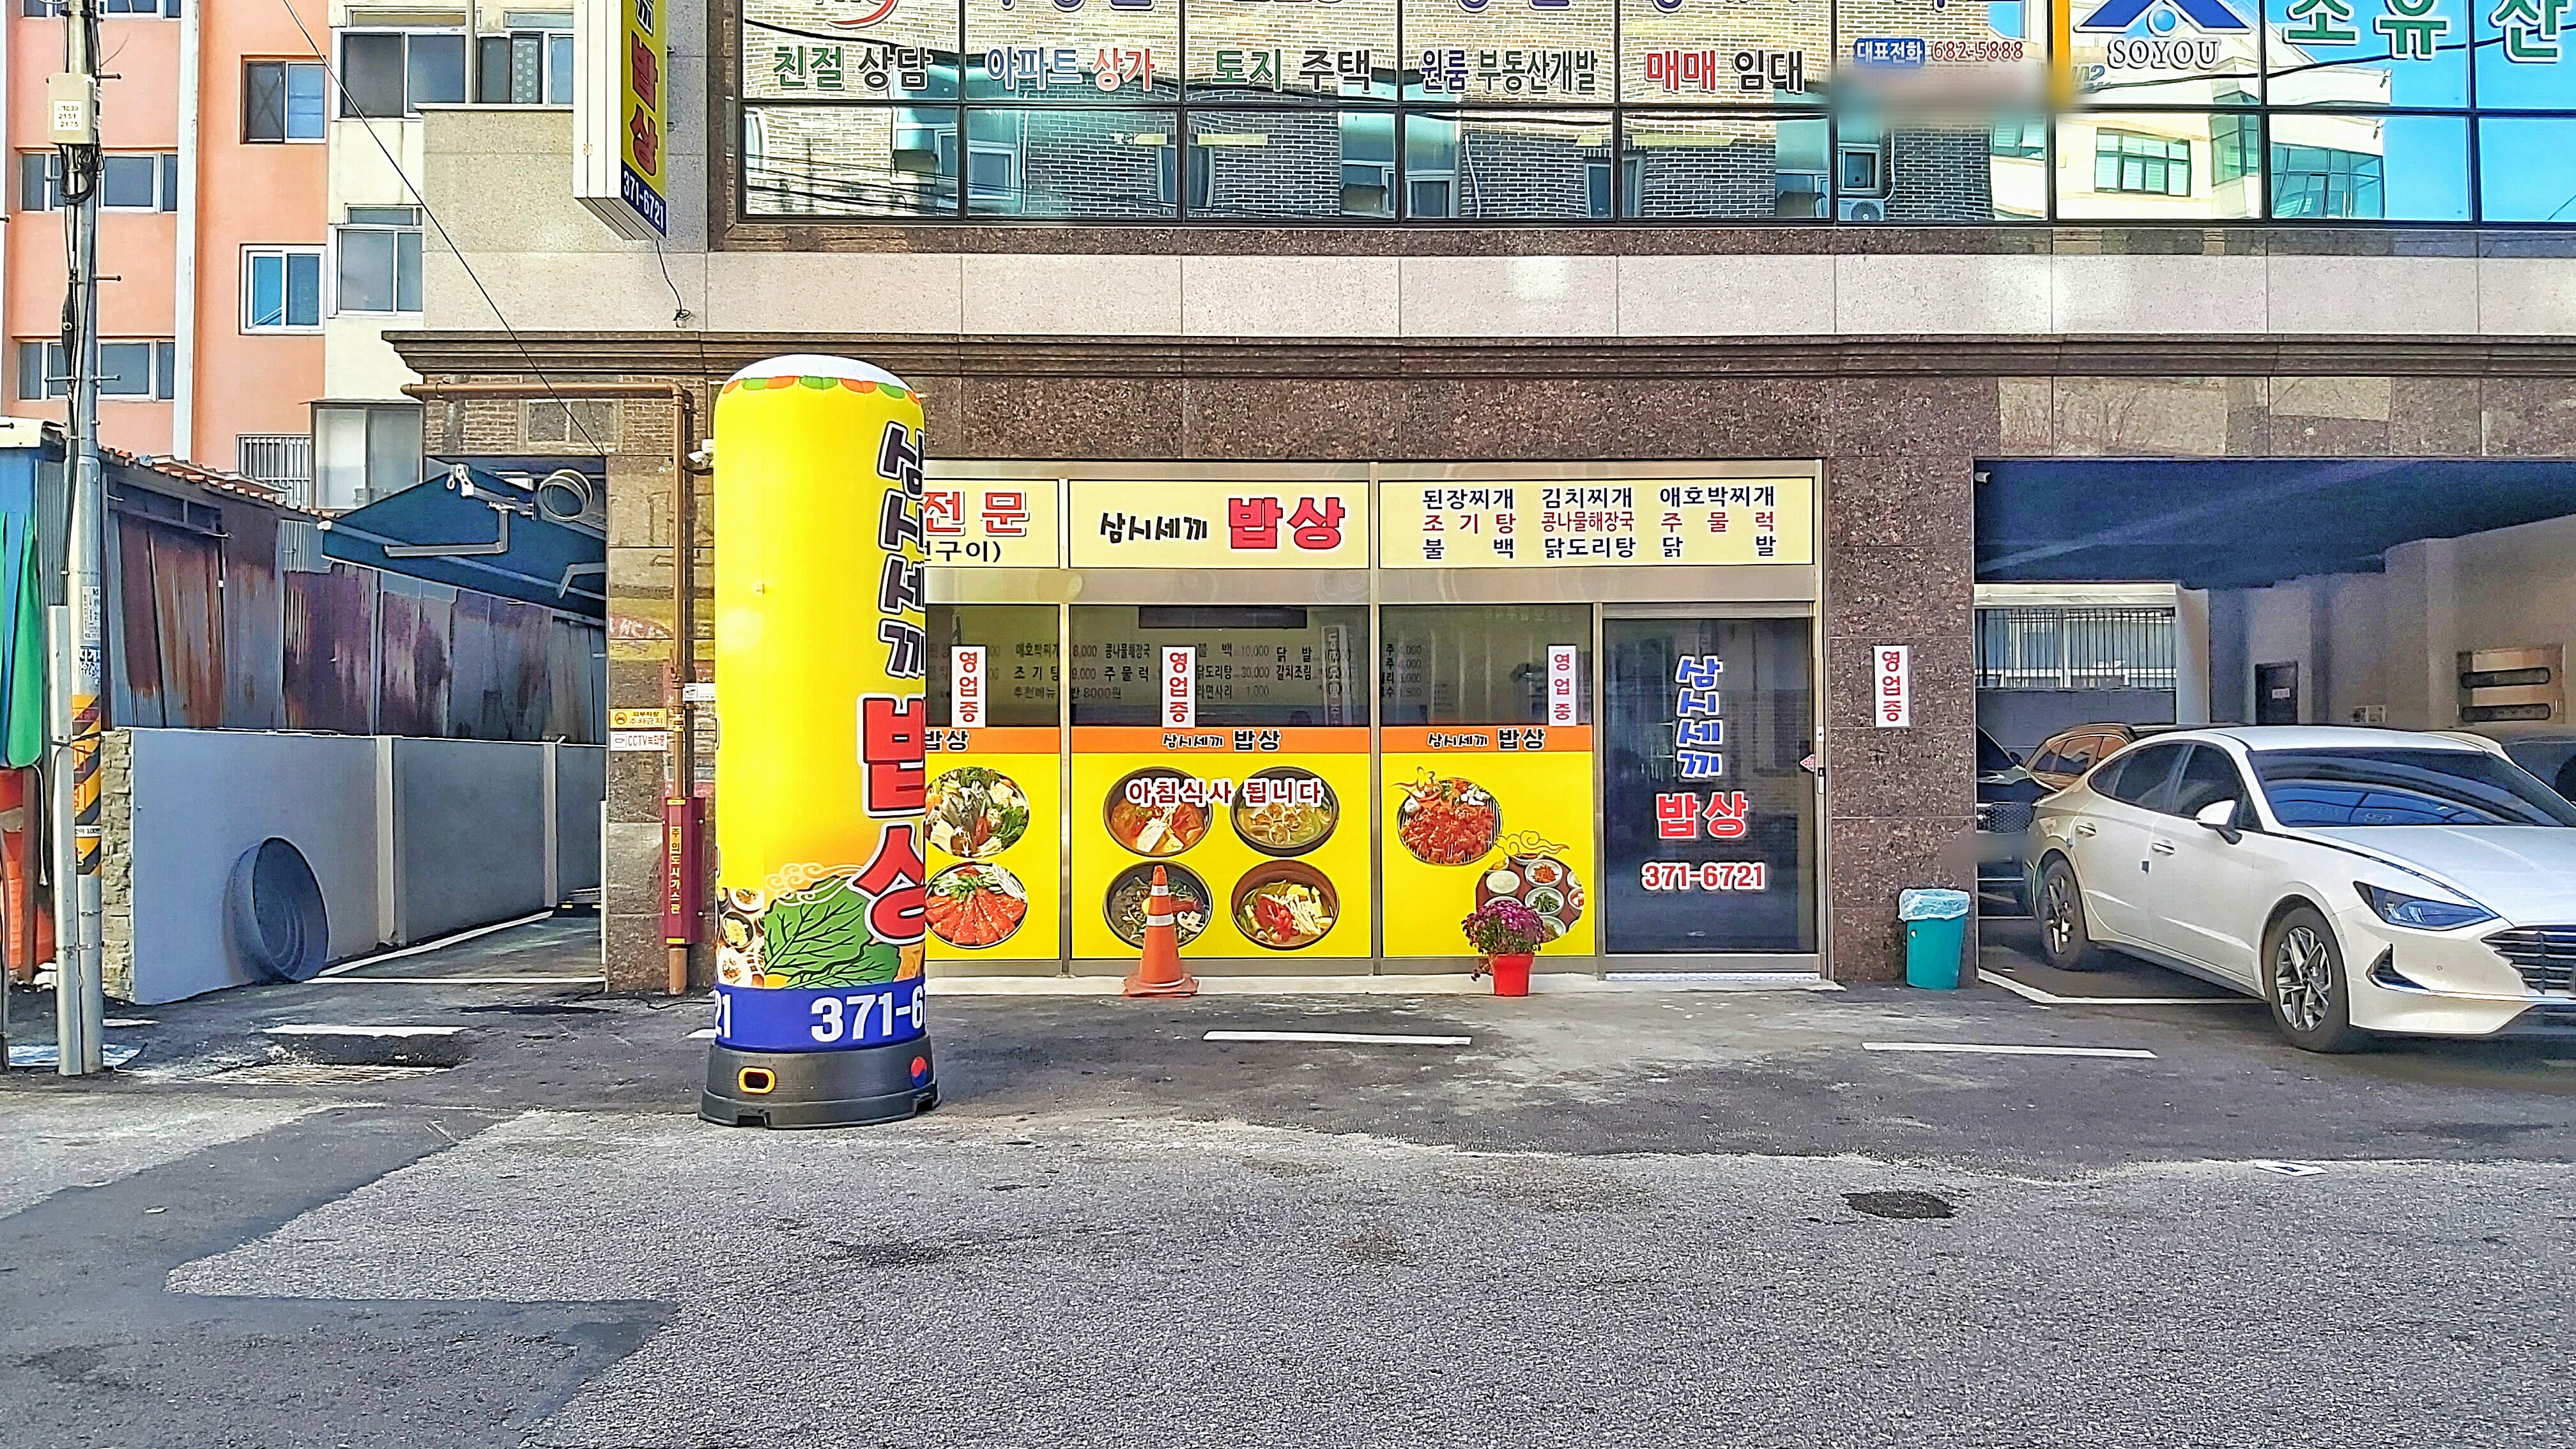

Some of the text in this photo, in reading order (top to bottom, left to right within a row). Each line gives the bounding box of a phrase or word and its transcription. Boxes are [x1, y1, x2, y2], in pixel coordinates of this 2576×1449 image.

[772, 46, 1805, 94] 친절 상담 아파트 상가 토지 주택 원룸 부동산개발 매매 임대
[1856, 40, 2024, 65] 대표전화 682-5888
[2108, 40, 2219, 66] SOYOU
[630, 31, 658, 176] 밥상
[623, 170, 664, 229] 371-6721
[924, 491, 1030, 535] 전문
[1422, 486, 1775, 509] 된장찌개 김치찌개 애호박찌개
[1099, 496, 1346, 549] 삼시세끼 밥상
[1541, 511, 1635, 533] 콩나물해장국
[924, 540, 1001, 563] 구이)
[1544, 537, 1636, 558] 닭도리탕
[959, 651, 978, 723] 영업중
[1169, 652, 1188, 723] 영업중
[1276, 664, 1312, 681] 갈치조림
[1553, 653, 1572, 721] 영업중
[1881, 650, 1899, 722] 영업중
[1677, 656, 1723, 776] 삼시세끼
[925, 730, 969, 751] 밥상
[1162, 730, 1280, 751] 삼시세끼 밥상
[1427, 728, 1545, 750] 삼시세끼 밥상
[1128, 778, 1324, 805] 아침식사 됩니다
[1657, 792, 1748, 839] 밥상
[1642, 862, 1766, 890] 371-6721
[811, 983, 926, 1043] 371-6
